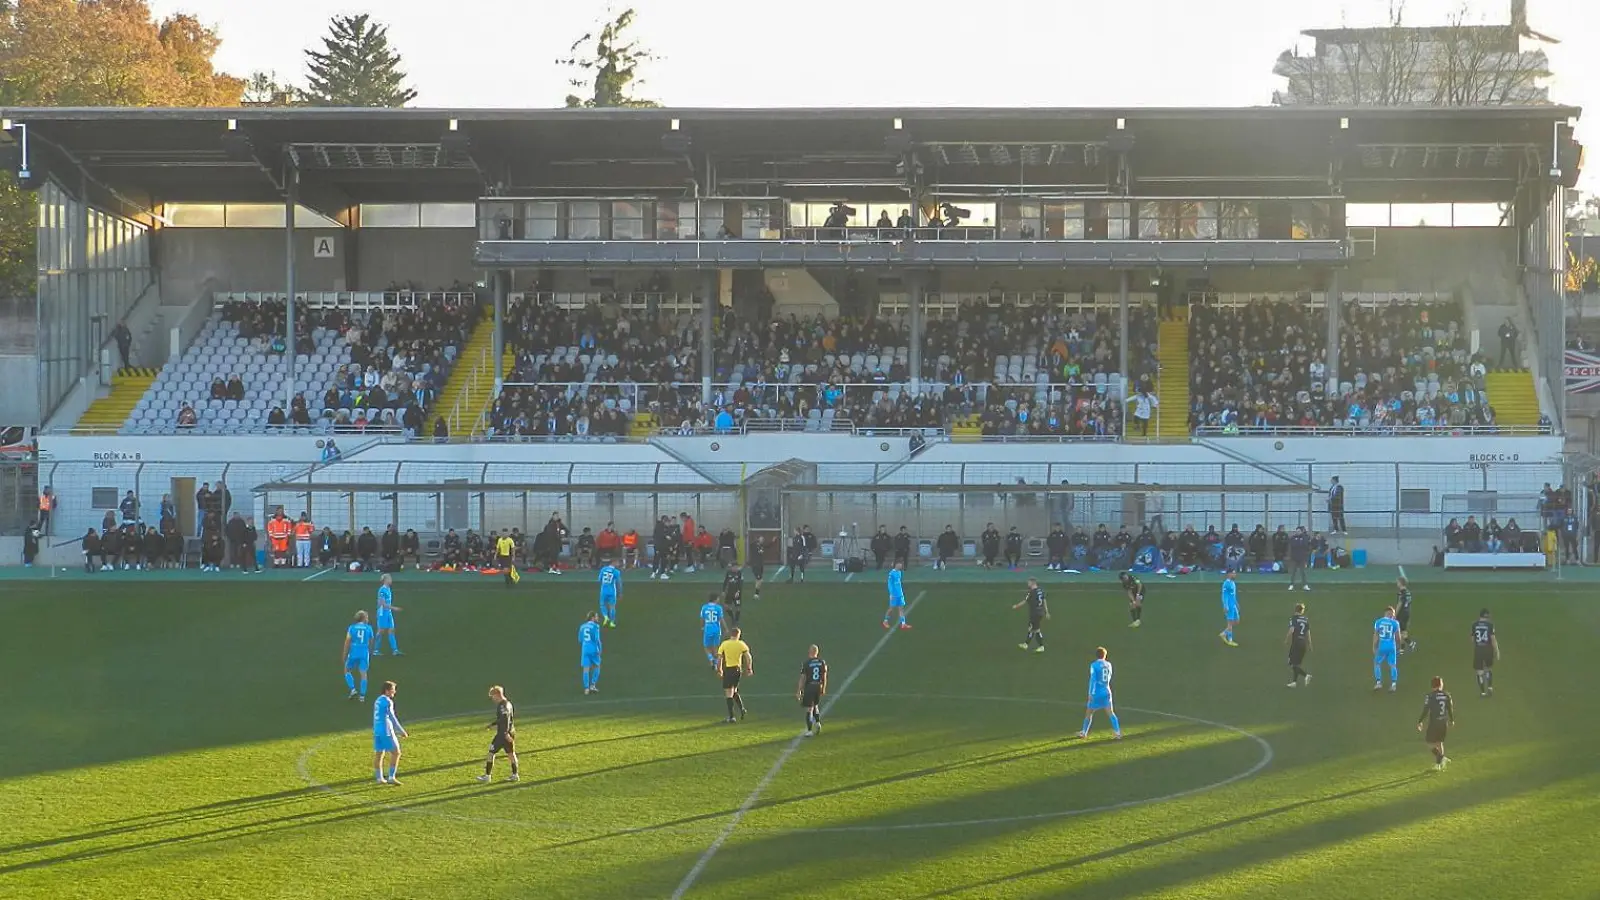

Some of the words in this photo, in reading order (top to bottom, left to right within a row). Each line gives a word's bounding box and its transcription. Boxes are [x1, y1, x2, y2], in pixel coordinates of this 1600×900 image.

[318, 239, 331, 254] A
[94, 452, 120, 460] BLOCK
[121, 452, 127, 460] A
[135, 452, 141, 460] B
[1469, 453, 1497, 461] BLOCK
[1499, 453, 1505, 461] C
[1513, 453, 1519, 461] D
[602, 571, 614, 584] 27
[1037, 593, 1044, 607] 5
[704, 610, 718, 623] 36
[583, 628, 591, 642] 5
[1300, 622, 1306, 635] 2
[1379, 624, 1394, 639] 34
[357, 629, 364, 643] 4
[1475, 630, 1489, 643] 34
[812, 667, 820, 680] 8
[1102, 668, 1109, 682] 8
[1439, 701, 1446, 715] 3
